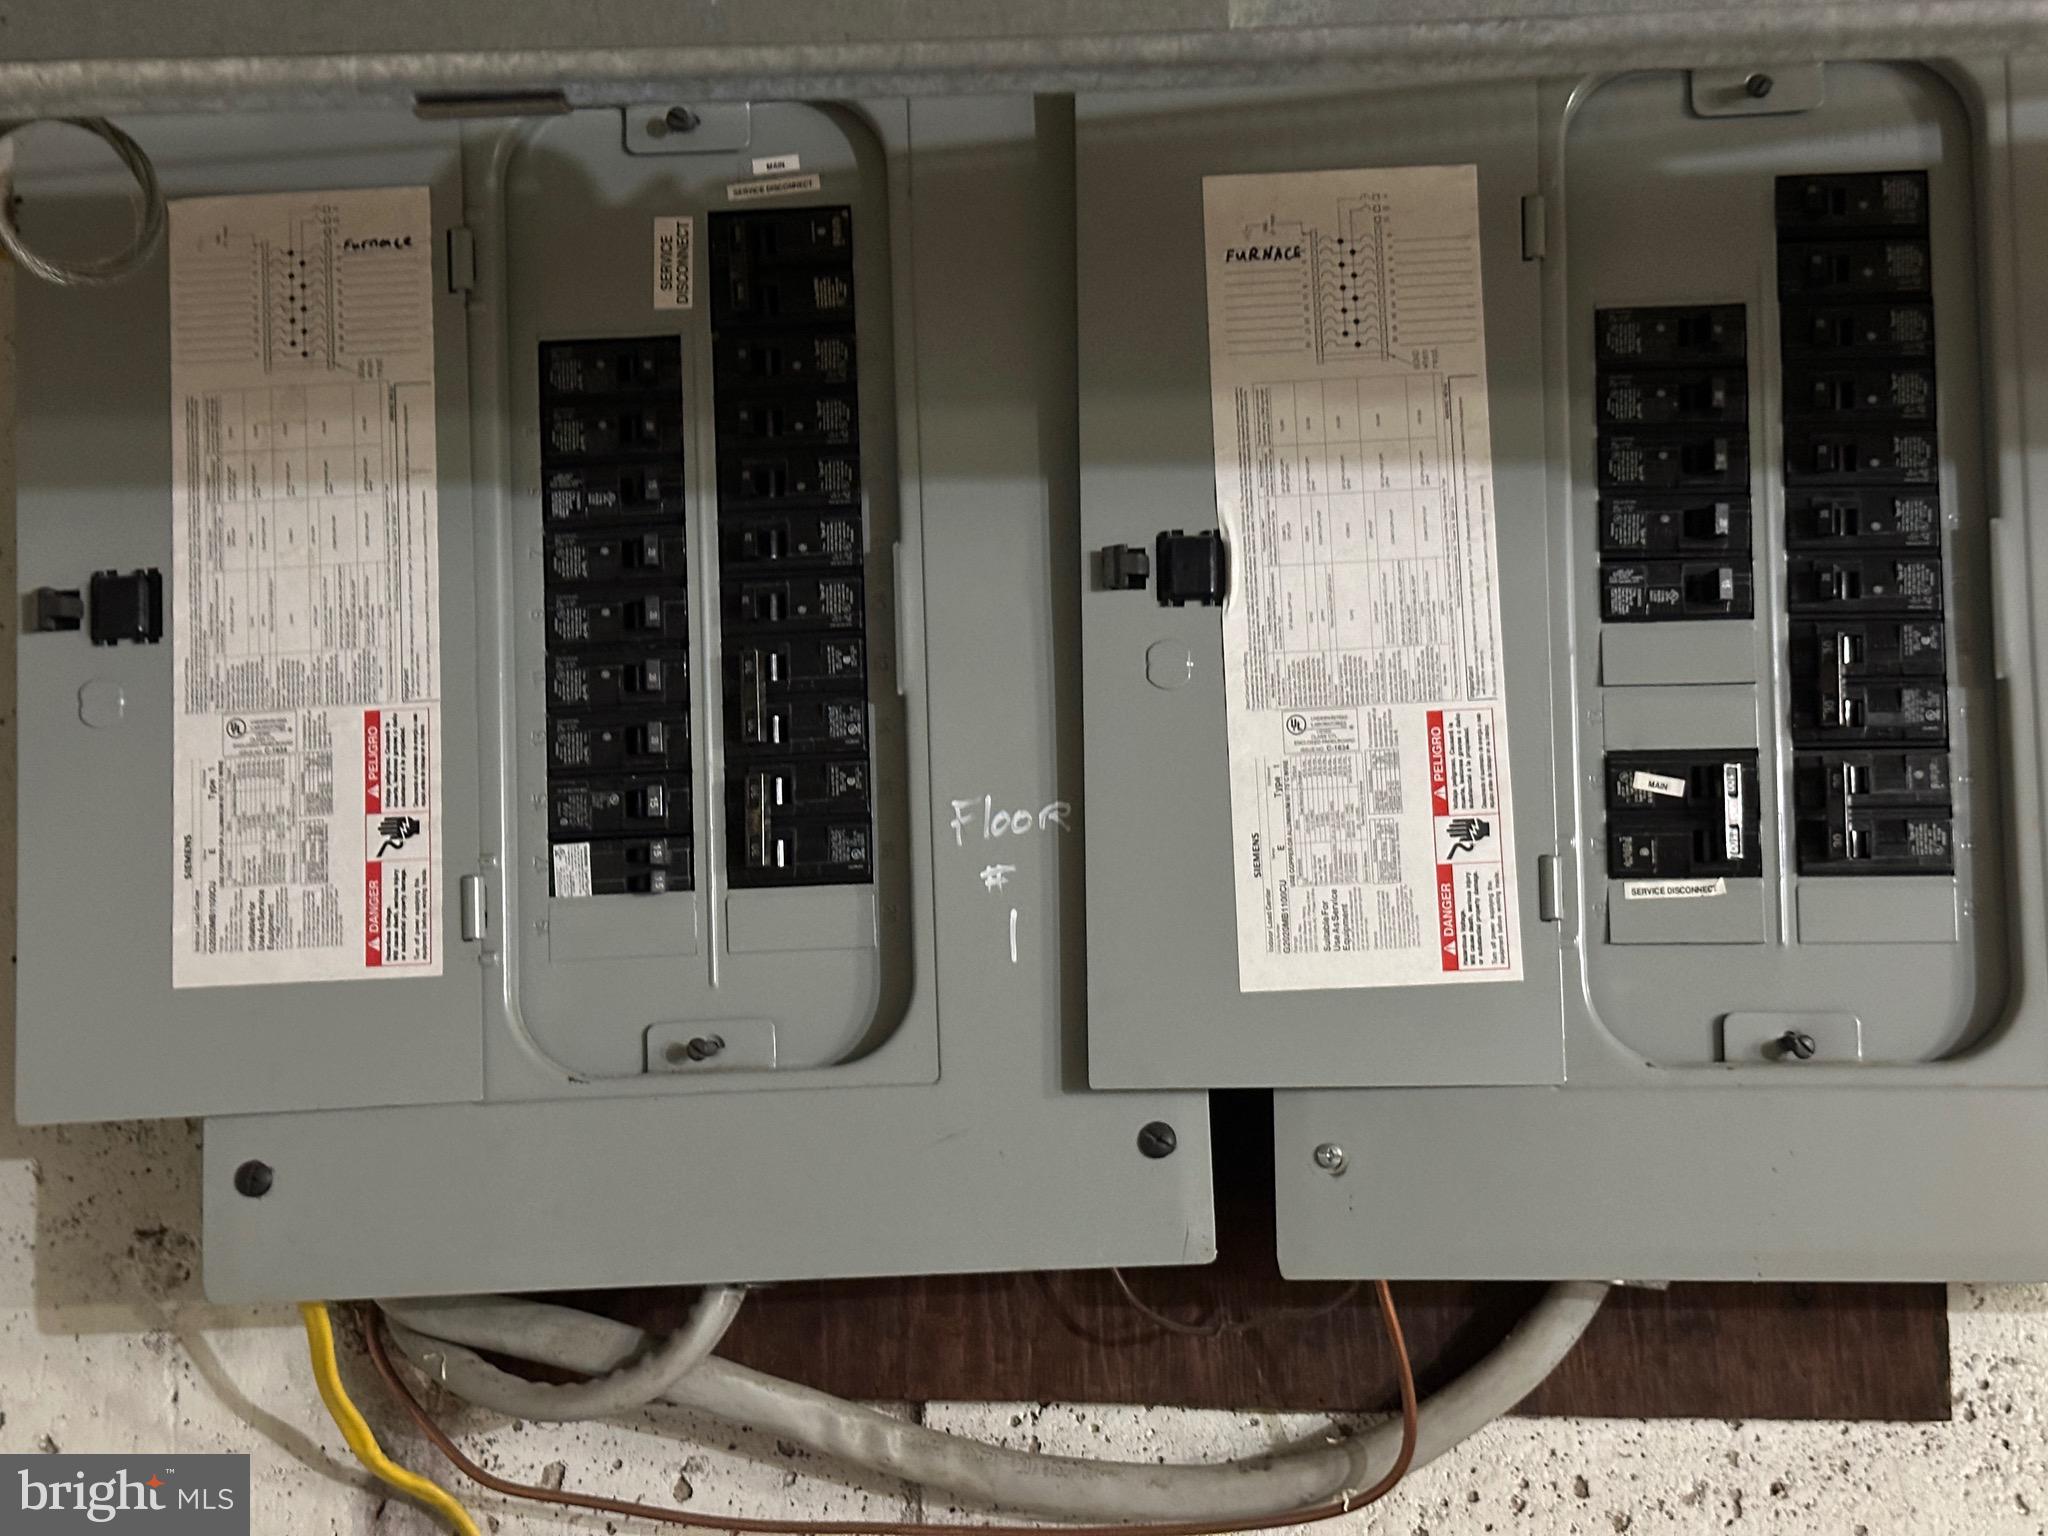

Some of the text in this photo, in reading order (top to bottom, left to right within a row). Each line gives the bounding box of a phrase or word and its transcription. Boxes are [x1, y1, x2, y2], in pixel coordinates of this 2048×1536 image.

[766, 161, 785, 170] MAIN
[732, 180, 813, 196] SERVICE DISCONNECT
[660, 235, 673, 291] SERVICE
[676, 221, 689, 304] DISCONNECT
[1225, 245, 1301, 263] FURNACE
[367, 725, 379, 781] PELIGRO
[1430, 726, 1444, 782] PELIGRO
[208, 778, 217, 801] Type
[649, 796, 658, 809] 15
[1273, 776, 1283, 798] Type
[1648, 780, 1668, 790] MAIN
[184, 834, 192, 880] SIEMENS
[653, 843, 663, 858] 15
[1251, 832, 1261, 878] SIEMENS
[1832, 833, 1842, 848] 30
[655, 875, 664, 889] 15
[980, 864, 1016, 893] #
[1631, 884, 1717, 896] SERVICE DISCONNECT
[368, 879, 379, 934] DANGER
[1330, 888, 1341, 952] Use As Service
[1440, 882, 1454, 937] DANGER
[1009, 908, 1017, 963] 1
[1321, 900, 1331, 952] Suitable For
[1340, 903, 1351, 951] Equipment
